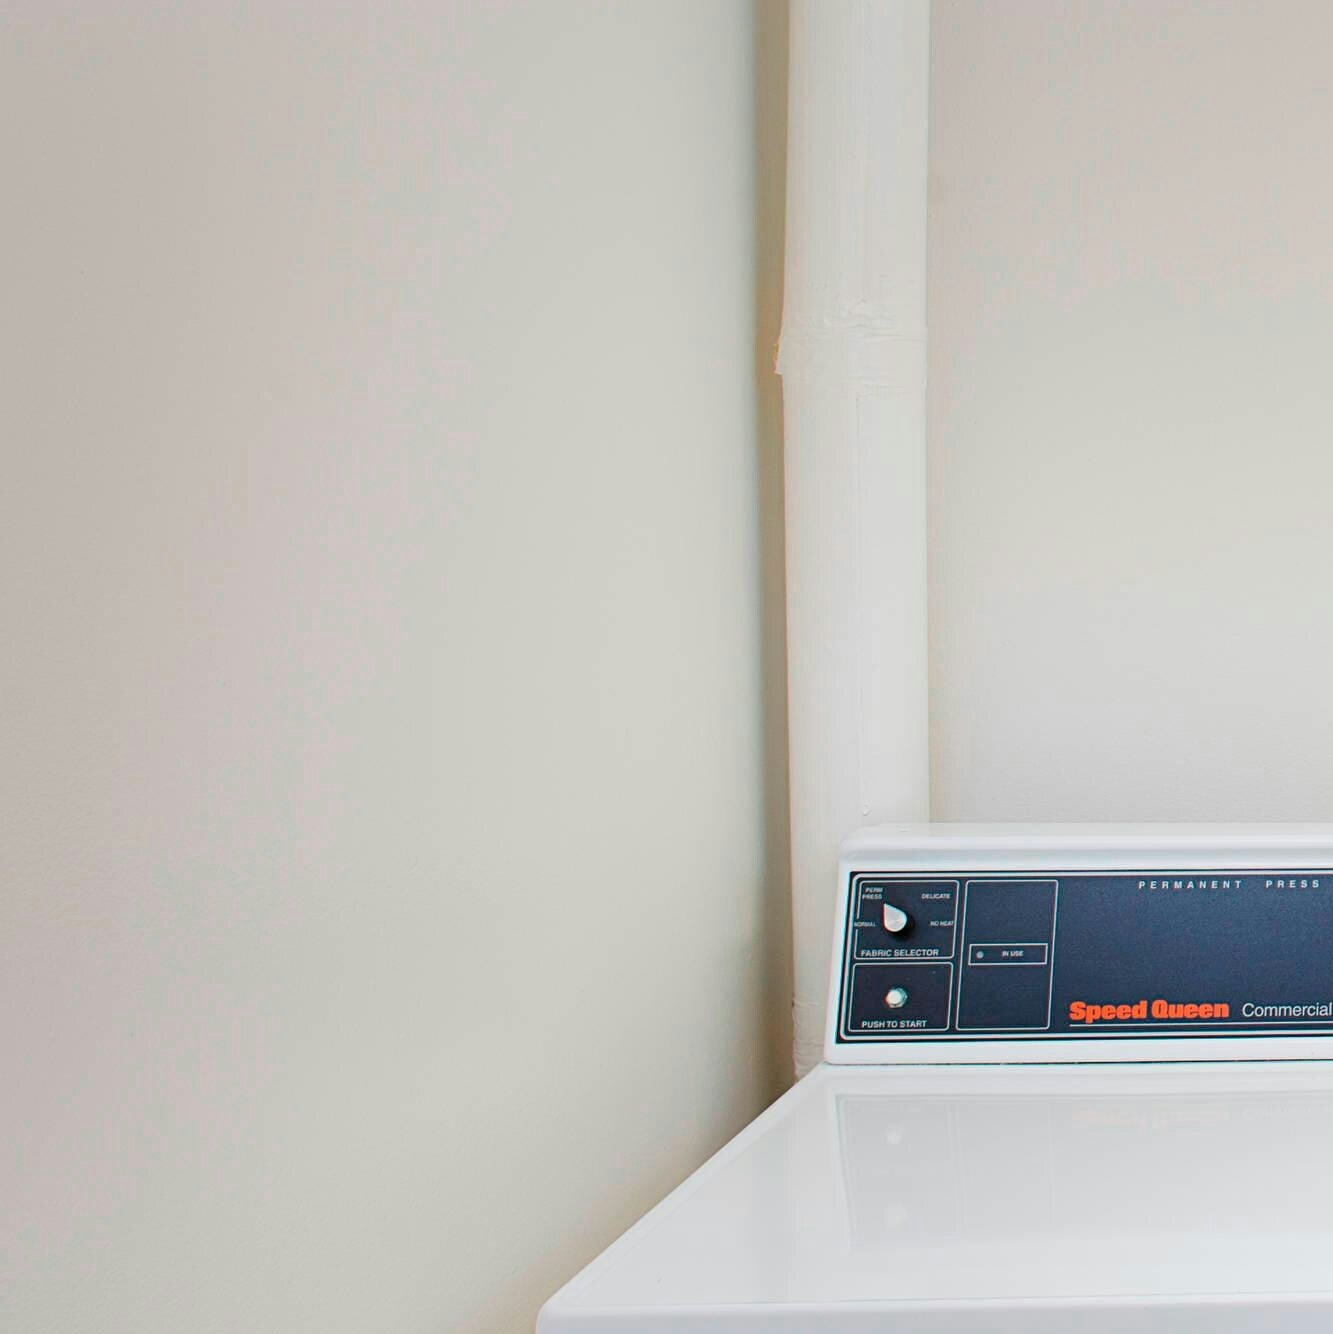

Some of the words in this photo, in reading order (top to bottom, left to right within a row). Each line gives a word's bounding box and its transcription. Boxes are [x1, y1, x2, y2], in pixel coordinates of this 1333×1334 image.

[1138, 879, 1243, 889] PERMANENT
[1265, 879, 1320, 889] PRESS
[860, 949, 892, 957] FABRIC
[893, 948, 939, 957] SELECTOR
[1069, 1001, 1147, 1024] Speed
[1151, 999, 1230, 1019] Queen
[1242, 1001, 1333, 1018] Commercial
[861, 1020, 885, 1029] PUSH
[887, 1020, 897, 1028] TO
[899, 1020, 928, 1028] START
